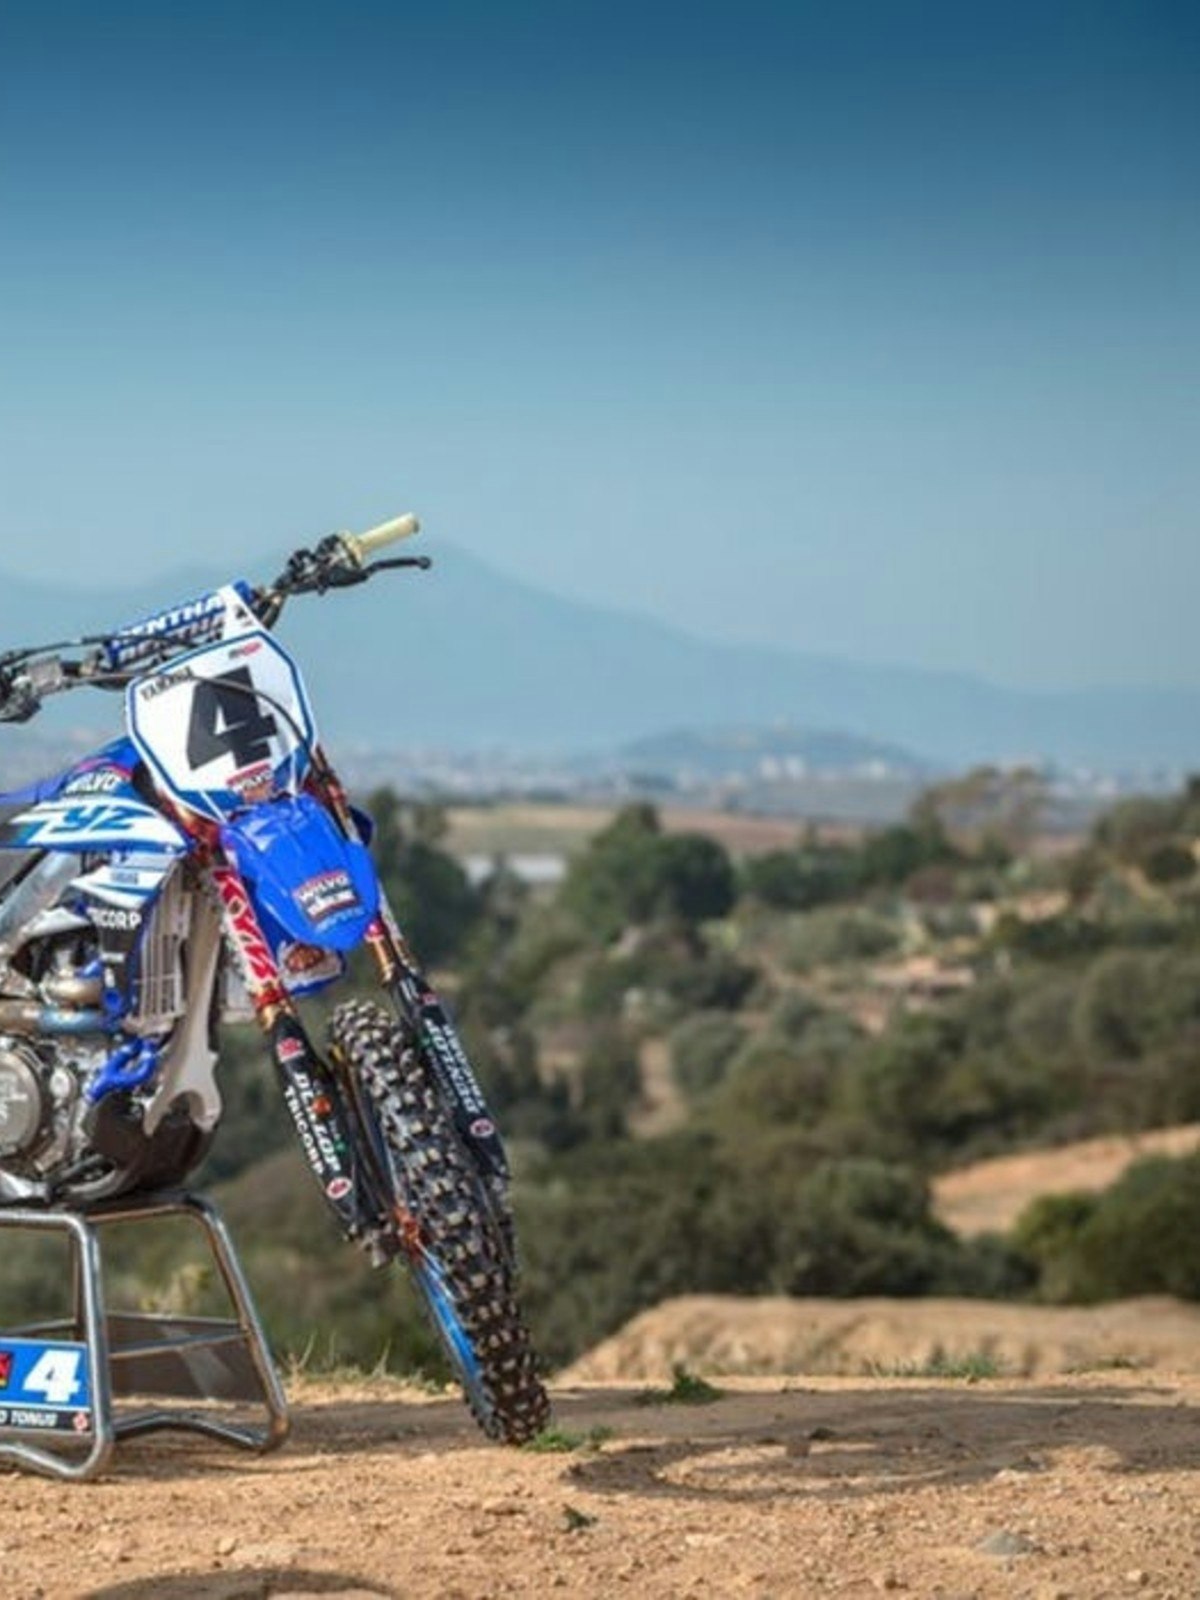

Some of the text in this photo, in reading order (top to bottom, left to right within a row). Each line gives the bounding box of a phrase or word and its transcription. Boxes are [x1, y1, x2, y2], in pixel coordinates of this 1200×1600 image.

[186, 665, 277, 772] 4
[283, 1084, 324, 1175] TRICORP
[22, 1348, 82, 1404] 4
